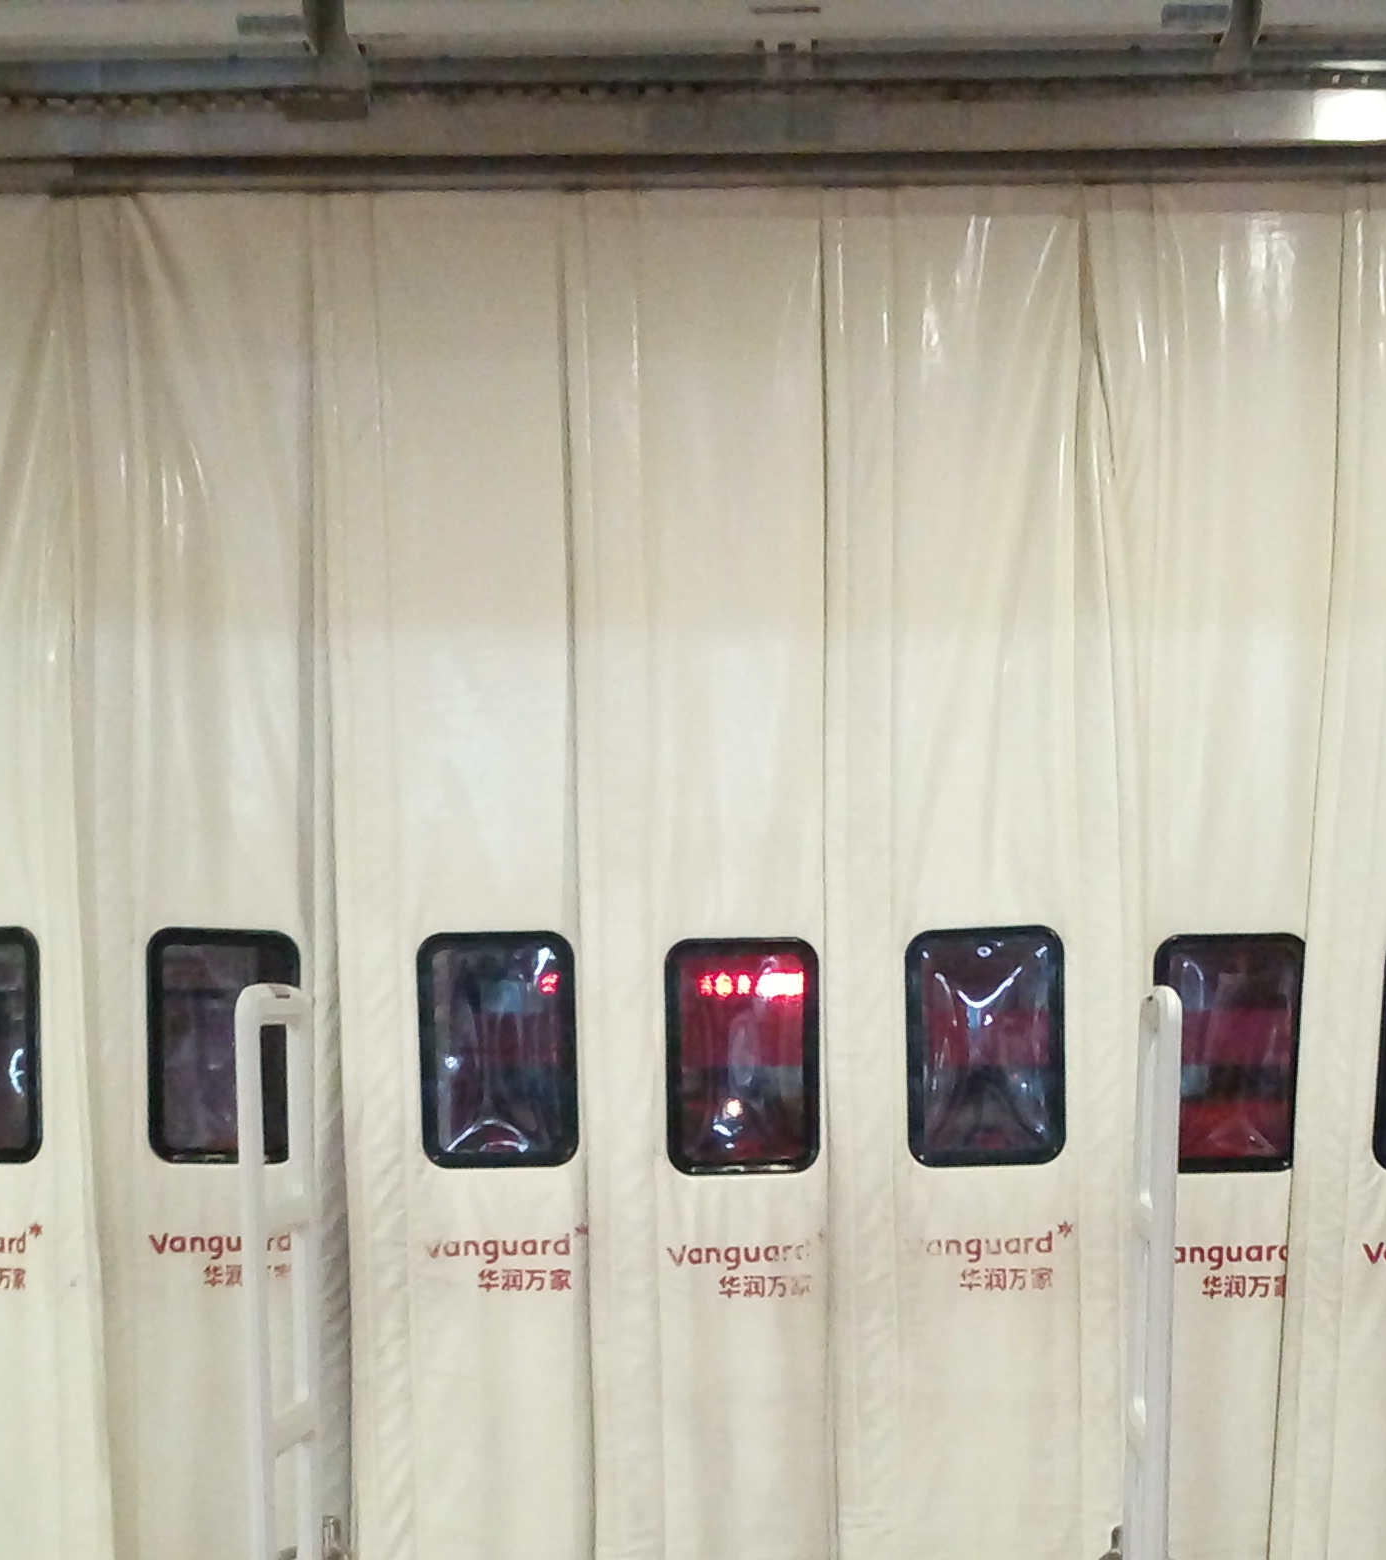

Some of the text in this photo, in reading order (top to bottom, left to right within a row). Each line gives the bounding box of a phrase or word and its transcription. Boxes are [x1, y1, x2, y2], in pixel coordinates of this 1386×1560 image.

[148, 1233, 291, 1260] Vangurd
[425, 1233, 570, 1264] Vanguard
[907, 1230, 1053, 1263] anguard
[1175, 1244, 1288, 1270] anguar
[478, 1269, 571, 1292] 华润万家
[960, 1267, 1053, 1291] 华润万家
